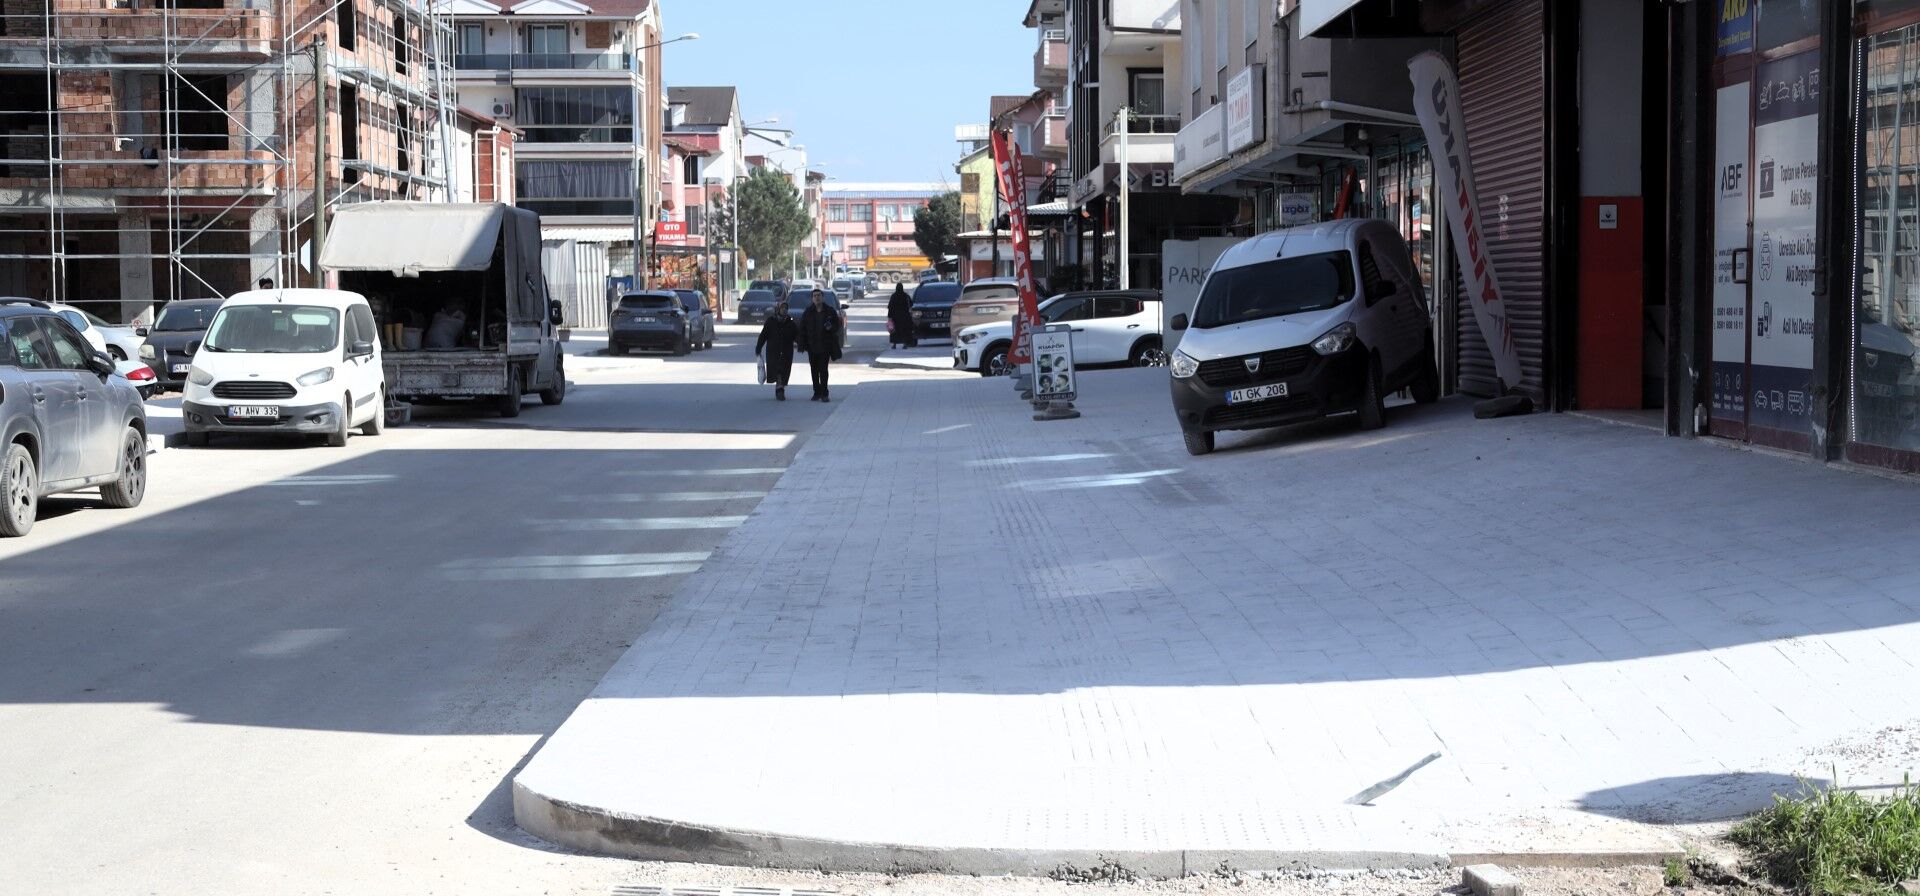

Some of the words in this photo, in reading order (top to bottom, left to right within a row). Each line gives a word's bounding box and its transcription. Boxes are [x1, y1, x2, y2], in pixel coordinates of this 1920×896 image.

[1721, 163, 1743, 194] ABF
[1780, 164, 1795, 184] Toptan
[1795, 166, 1800, 180] ve
[1790, 188, 1799, 206] Akü
[1778, 236, 1796, 256] Ücretsiz
[1796, 237, 1805, 256] Akü
[1169, 266, 1210, 287] PARK
[1786, 265, 1795, 283] Akü
[1783, 318, 1791, 335] Acil
[1232, 390, 1242, 402] 41
[1246, 387, 1261, 400] GK
[1266, 384, 1286, 397] 208
[233, 406, 242, 415] 41
[245, 406, 260, 415] AHV
[263, 406, 278, 415] 335
